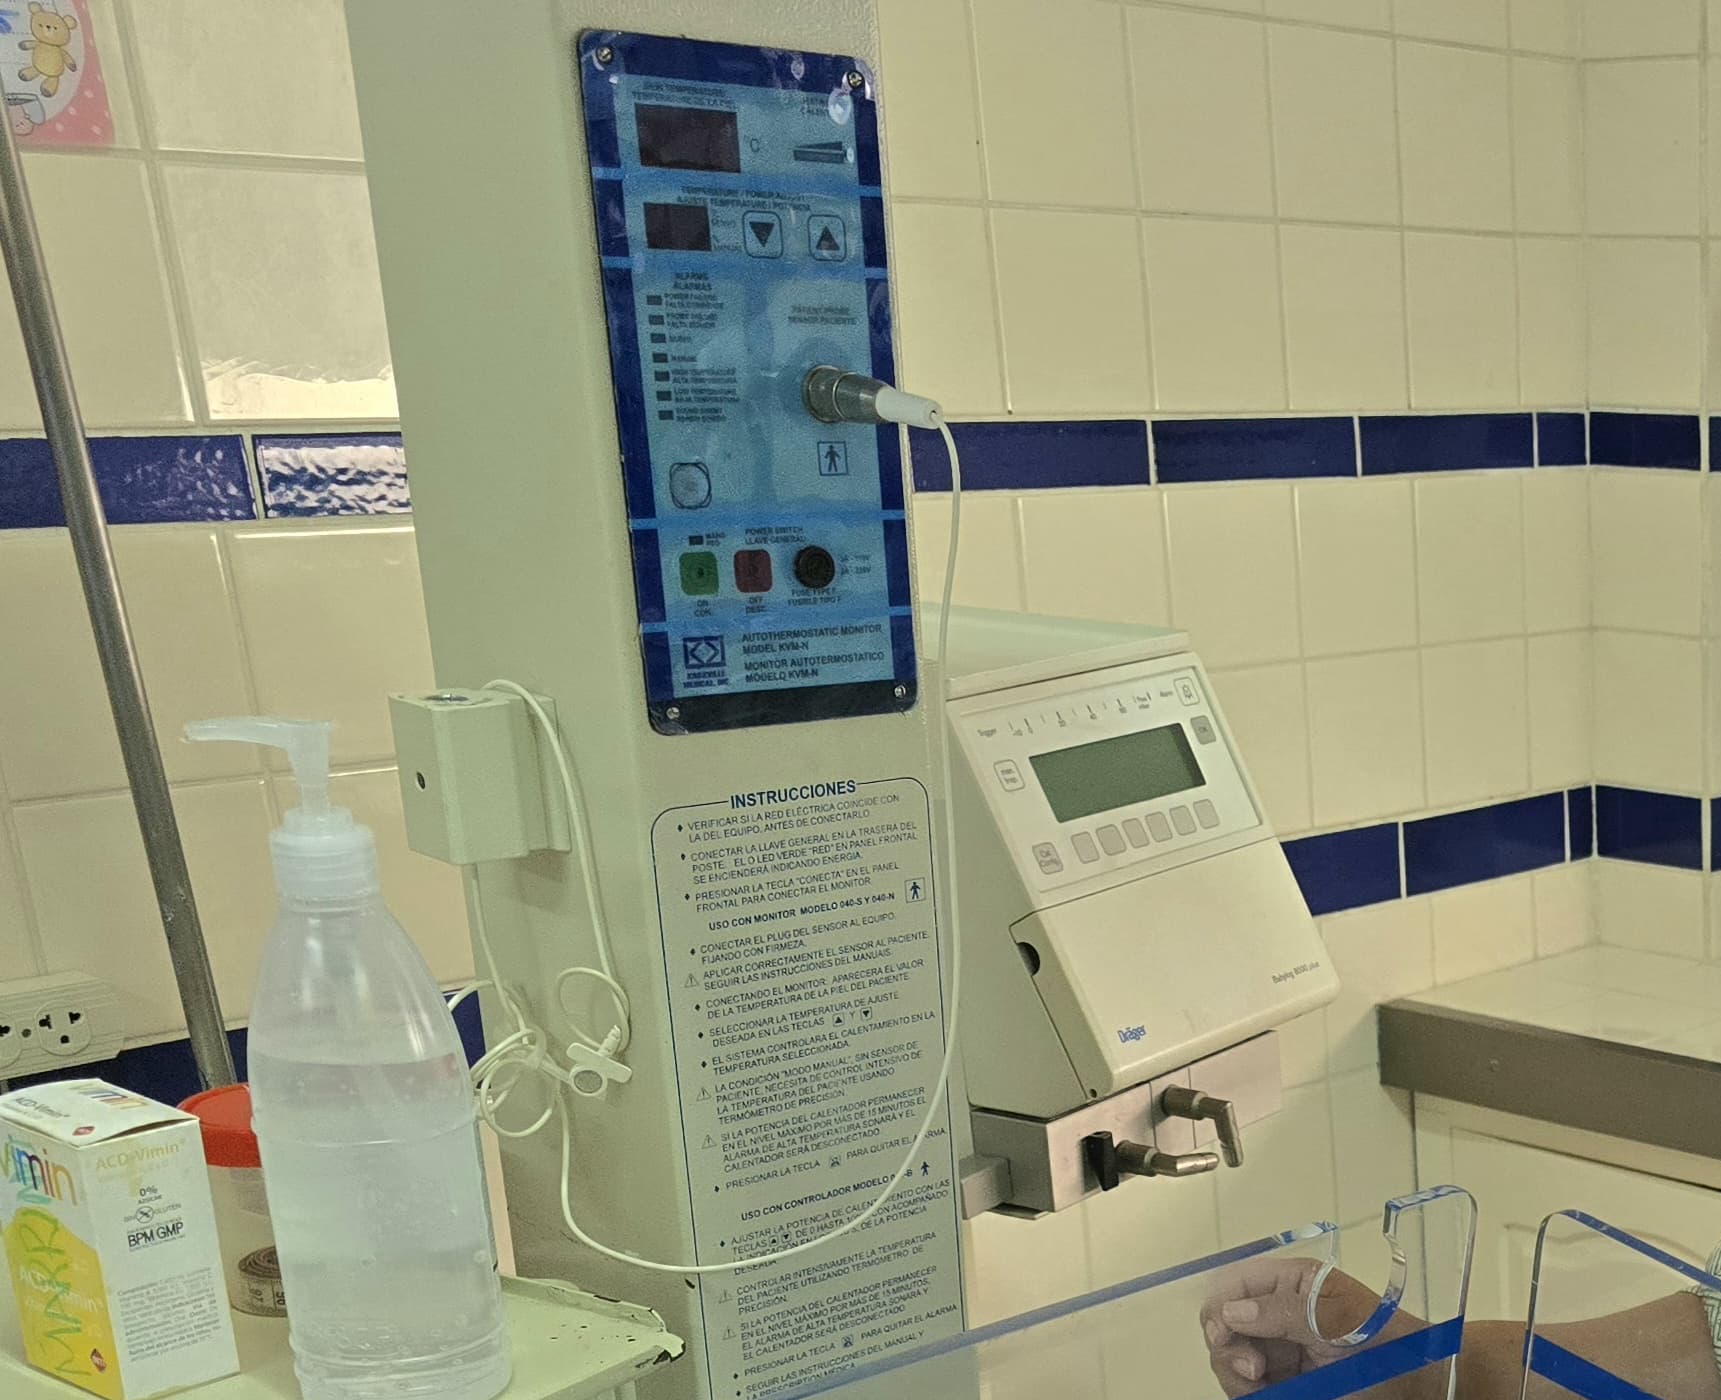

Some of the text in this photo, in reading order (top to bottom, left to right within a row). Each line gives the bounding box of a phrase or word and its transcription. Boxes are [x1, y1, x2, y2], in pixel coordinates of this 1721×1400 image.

[742, 624, 882, 642] AUTOTHERMOSTATIC MONITOR
[742, 644, 776, 654] MODEL
[744, 651, 884, 671] MONITOR AUTOTERMOSTATICO
[745, 671, 786, 682] MODELO
[730, 779, 856, 809] INSTRUCCIONES
[708, 919, 729, 931] USO
[731, 915, 751, 927] CON
[753, 907, 796, 923] MONITOR
[799, 900, 838, 915] MODELO
[864, 895, 870, 904] Y
[1117, 1024, 1146, 1043] Dräger
[139, 1185, 157, 1197] 0%
[741, 1208, 760, 1221] USO
[762, 1202, 782, 1216] CON
[783, 1184, 851, 1210] CONTROLADOR
[852, 1175, 889, 1192] MODELO
[128, 1229, 155, 1248] BPM
[156, 1222, 183, 1239] GMP
